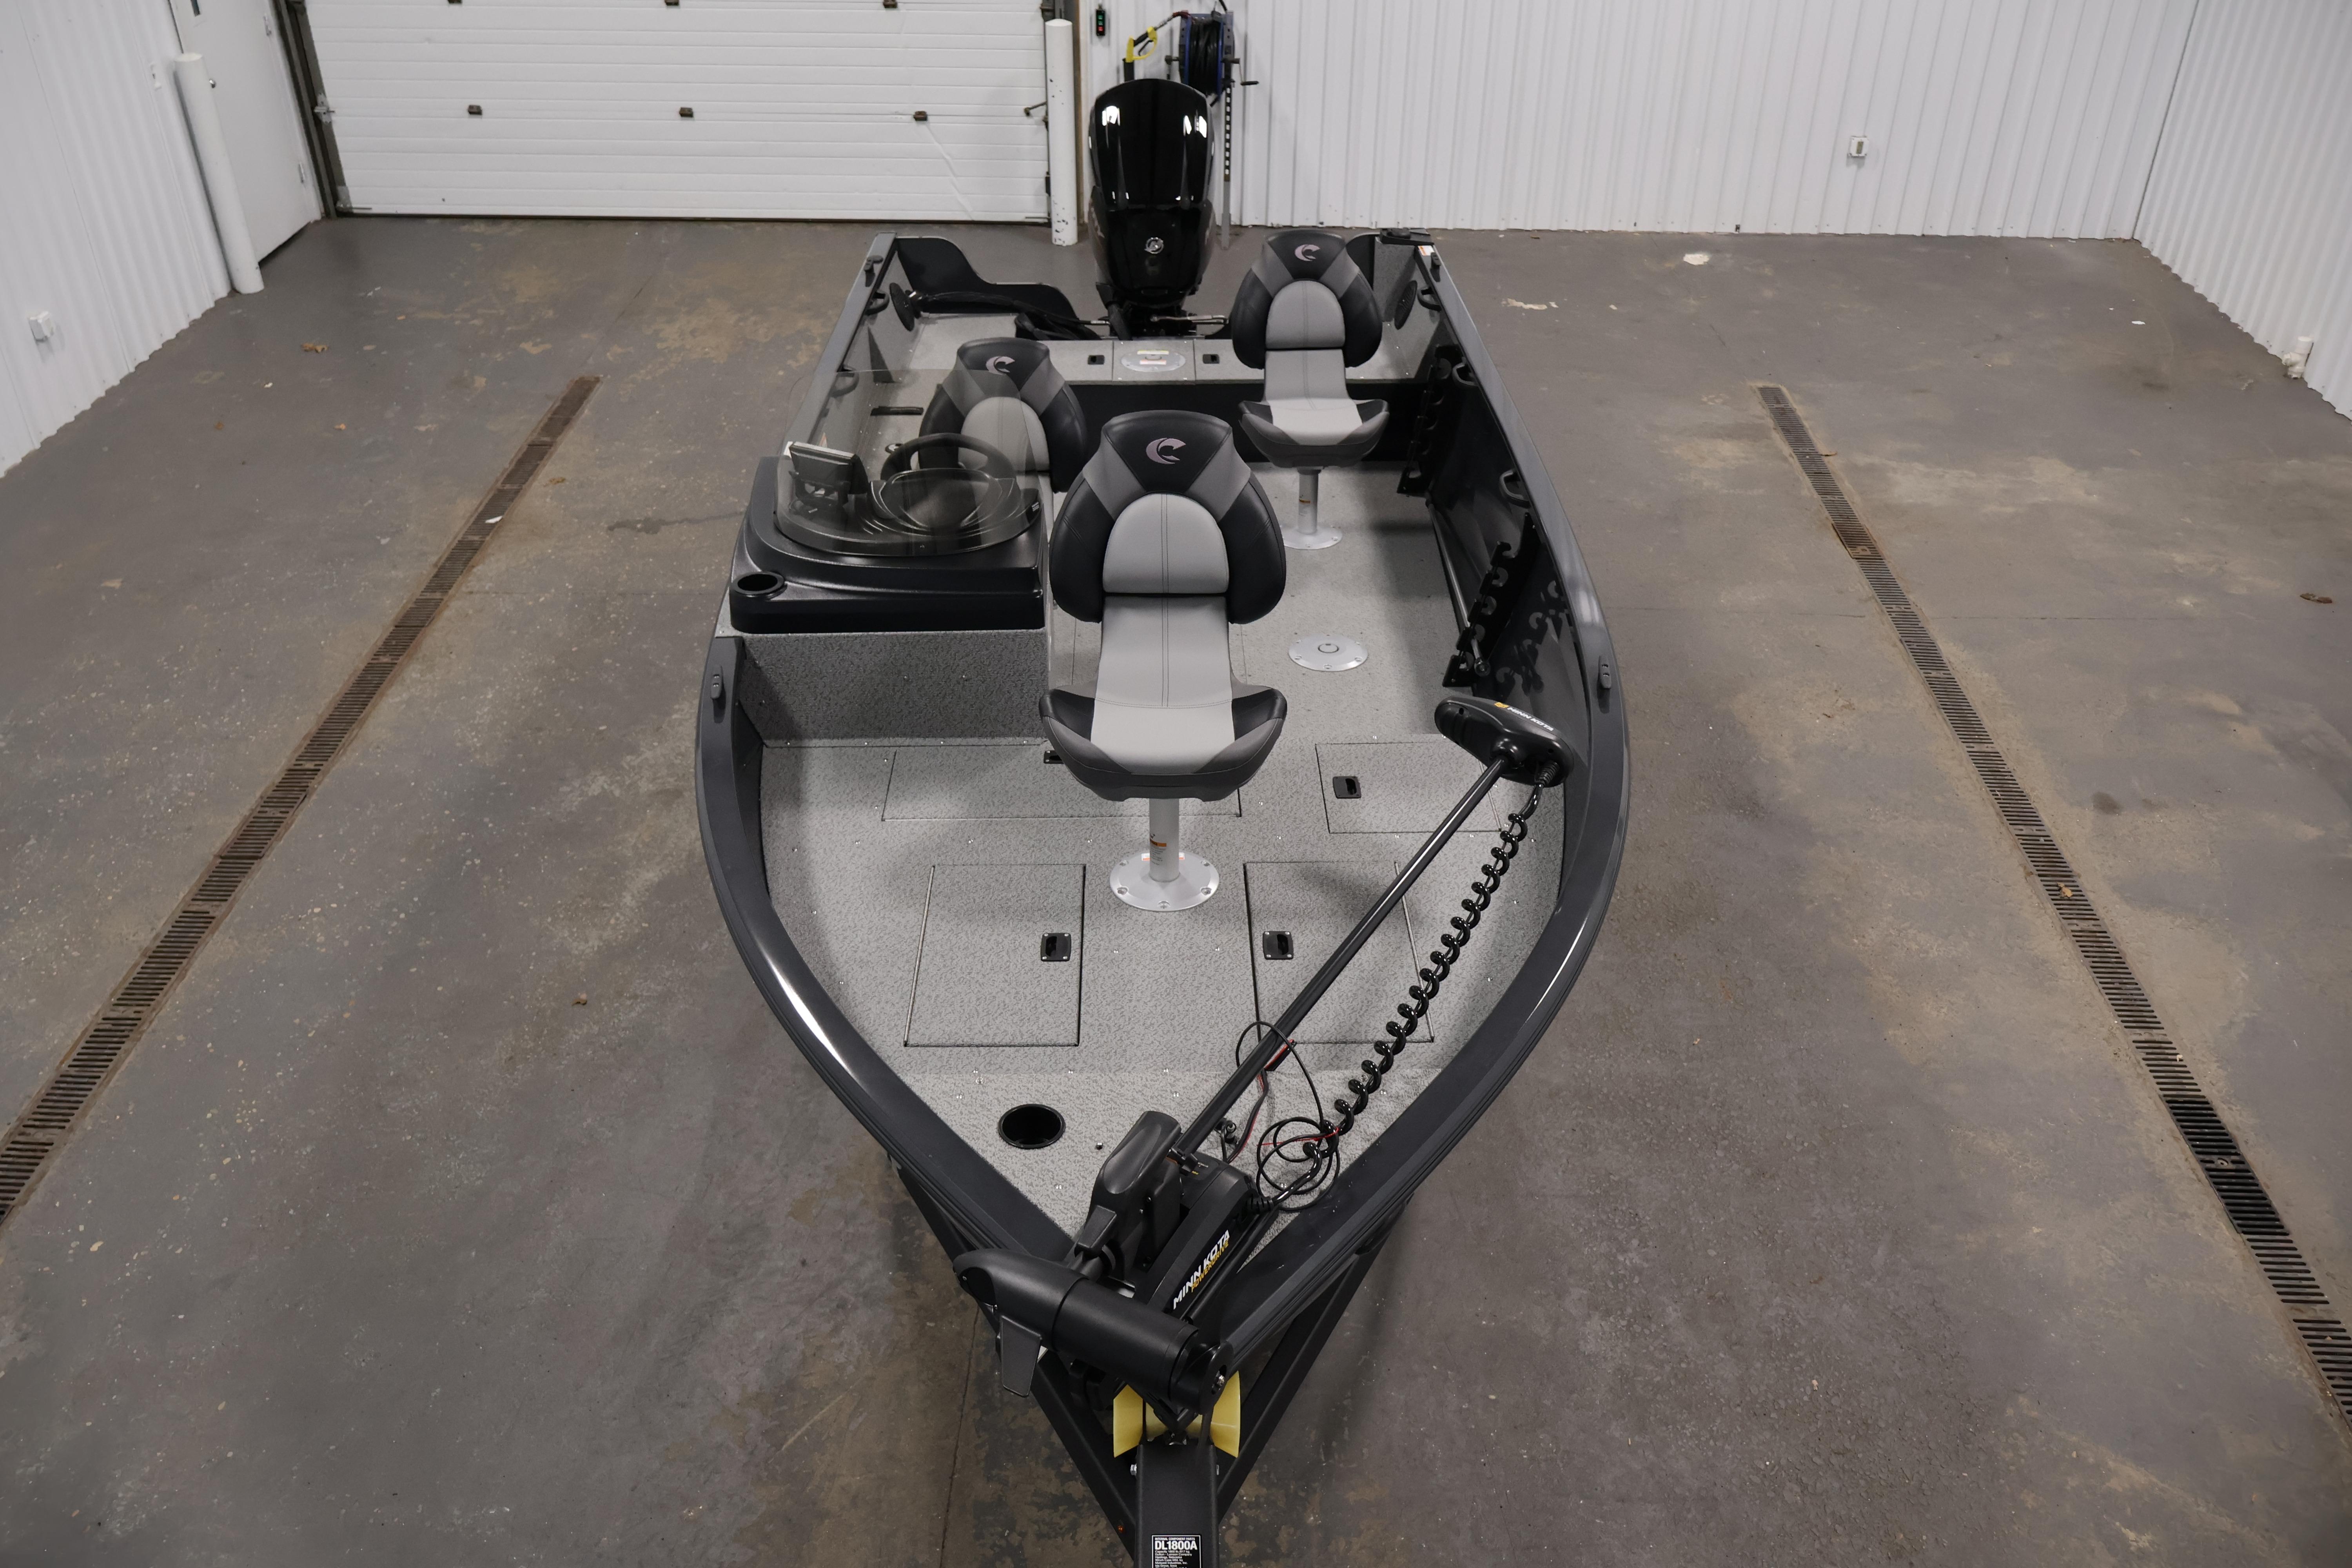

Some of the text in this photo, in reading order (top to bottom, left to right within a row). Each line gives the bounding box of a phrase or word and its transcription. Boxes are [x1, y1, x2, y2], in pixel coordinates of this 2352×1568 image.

[1507, 707, 1554, 731] MINN KOTA
[1174, 1229, 1230, 1310] MINN KOTA
[1192, 1240, 1229, 1293] POWERDRIVE
[1155, 1541, 1198, 1550] DL1800A
